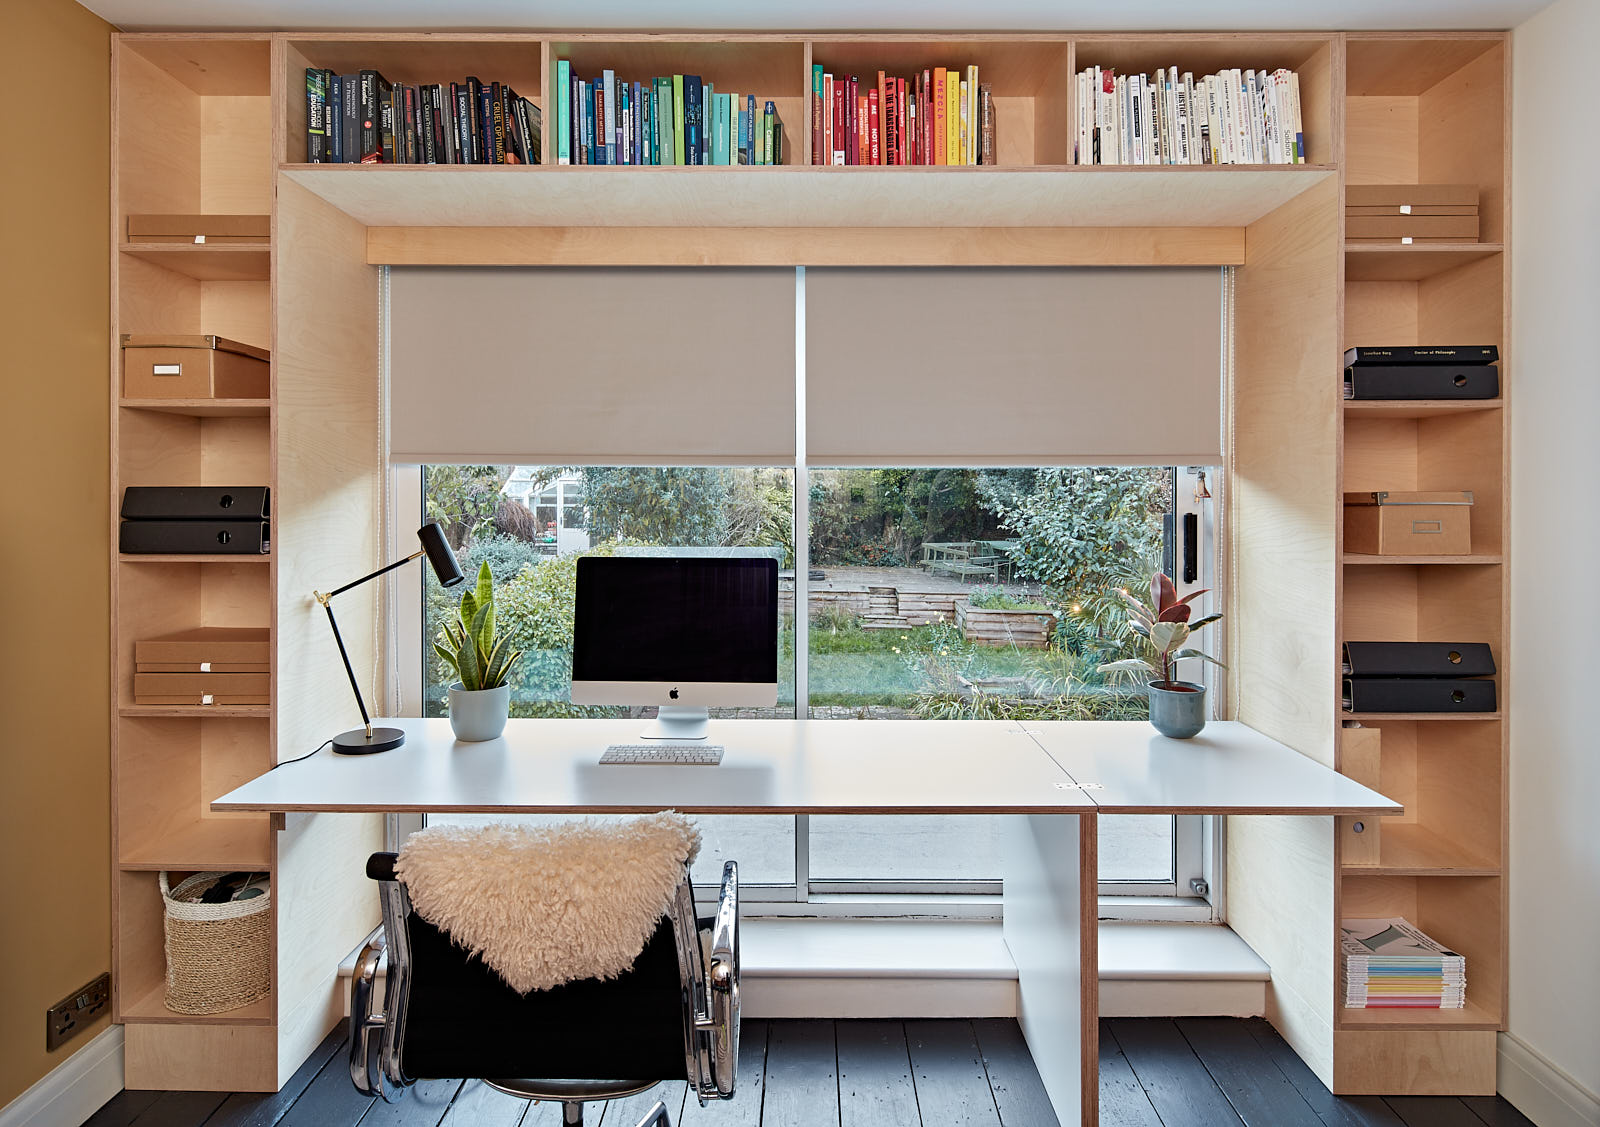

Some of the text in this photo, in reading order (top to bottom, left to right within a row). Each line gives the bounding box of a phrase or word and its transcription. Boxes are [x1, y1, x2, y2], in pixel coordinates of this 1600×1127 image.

[886, 93, 894, 104] THE
[1178, 92, 1186, 118] JUSTICE
[460, 118, 468, 141] THEORY
[493, 102, 503, 162] CRUEL OPTIMISM
[886, 106, 894, 149] TRANSGENDER
[1284, 129, 1292, 156] Saldaña
